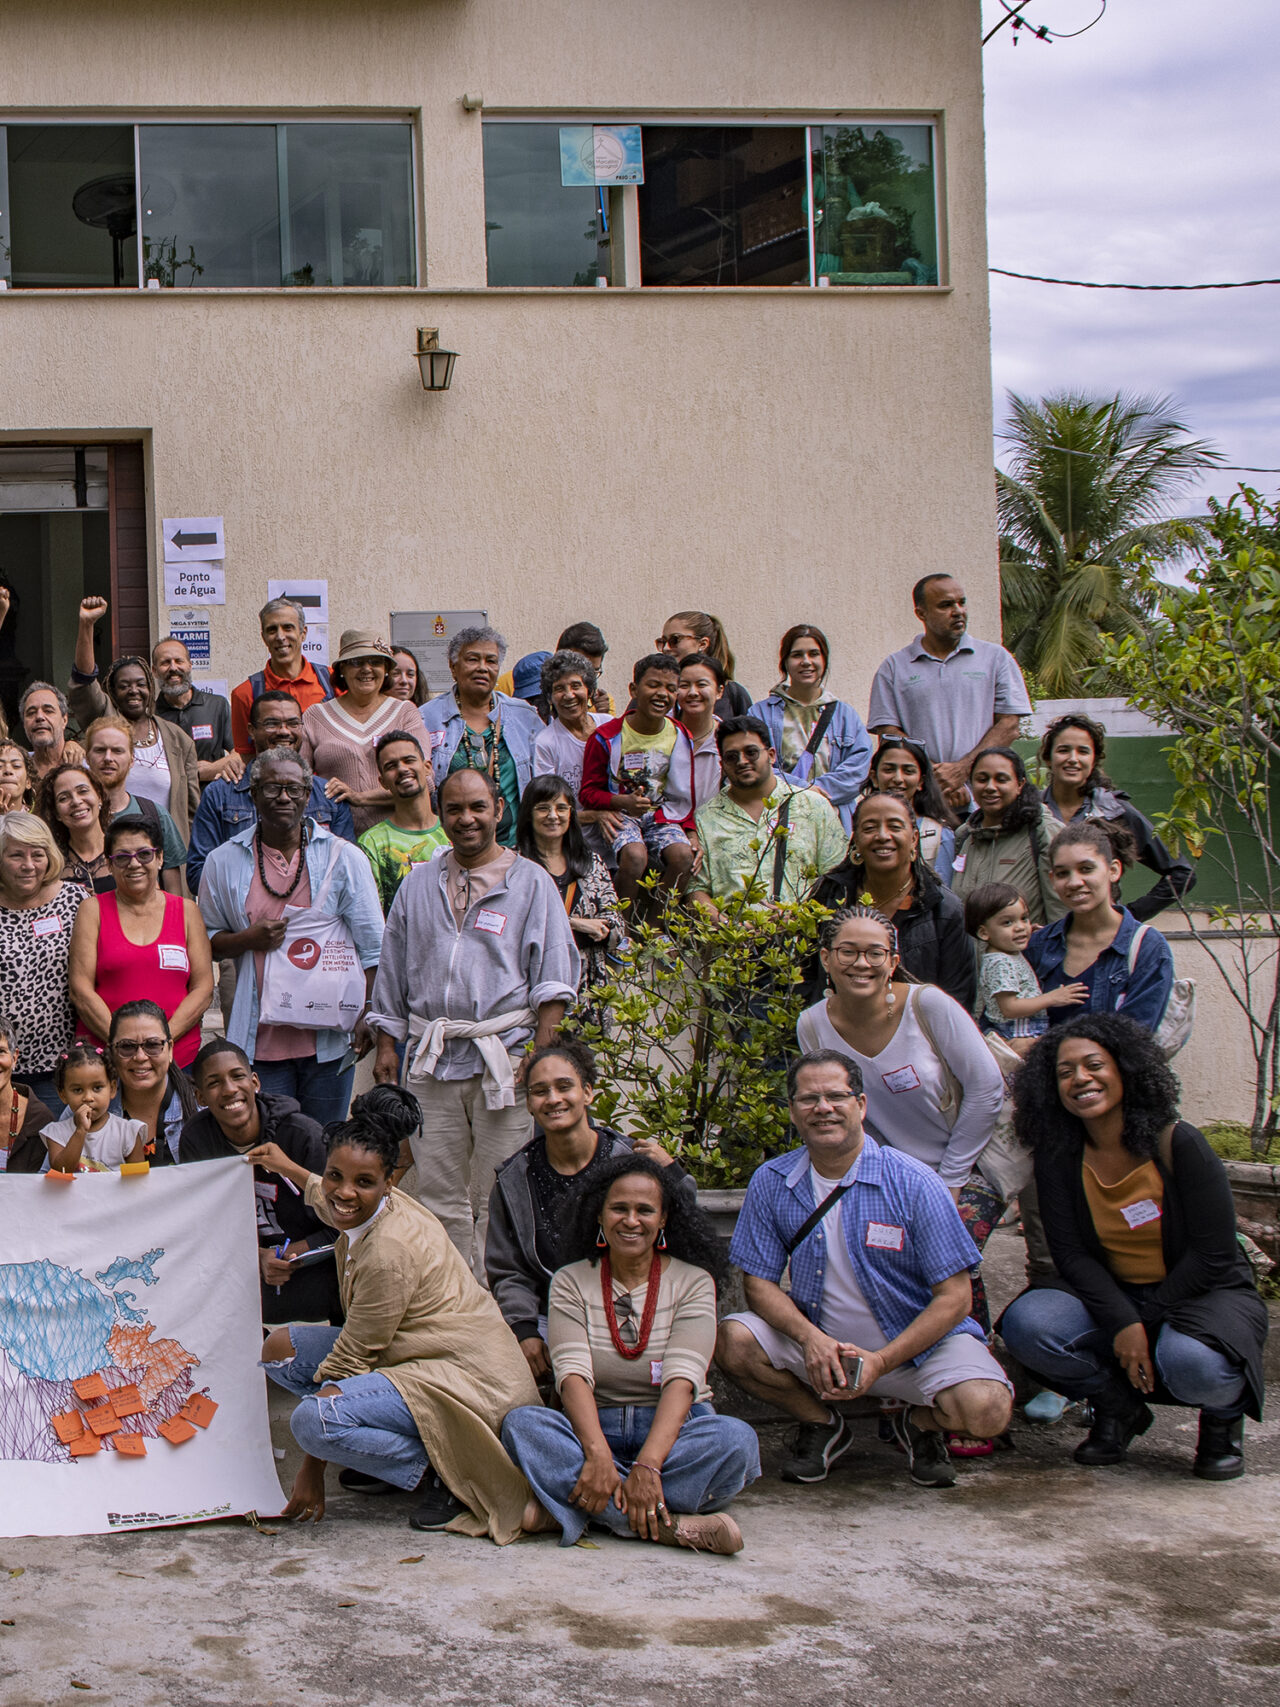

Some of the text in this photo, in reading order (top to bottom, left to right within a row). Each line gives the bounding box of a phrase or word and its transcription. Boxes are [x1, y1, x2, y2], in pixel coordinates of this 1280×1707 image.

[180, 572, 210, 582] Ponto
[174, 582, 216, 597] de Água
[171, 632, 209, 641] ALARME
[302, 641, 323, 651] eiro
